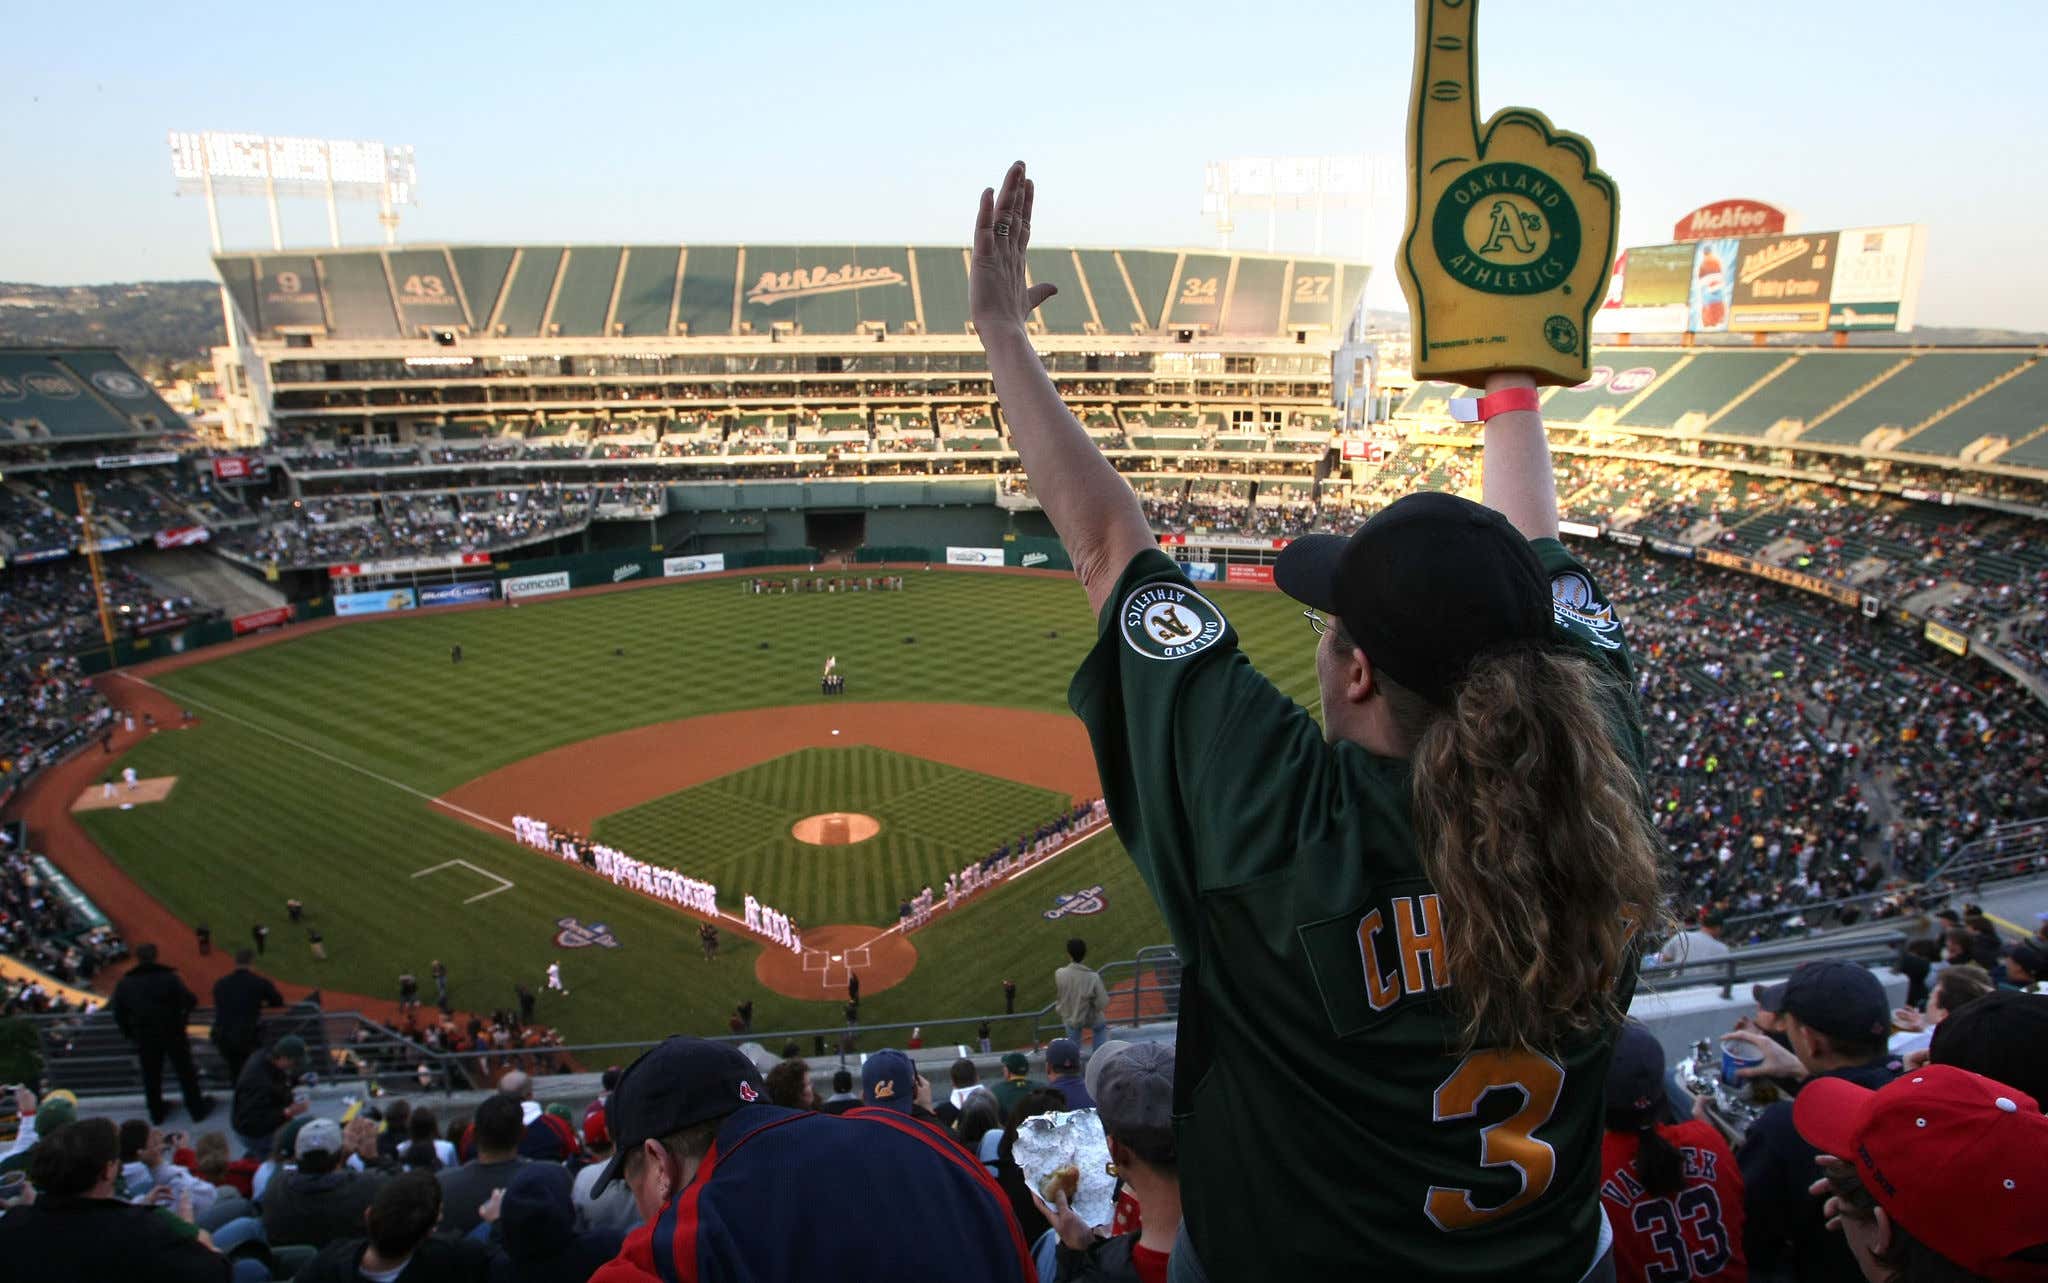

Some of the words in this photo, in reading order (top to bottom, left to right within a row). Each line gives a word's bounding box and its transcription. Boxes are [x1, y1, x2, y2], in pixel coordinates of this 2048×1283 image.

[1454, 171, 1560, 208] OAKLAND
[1479, 201, 1542, 254] A's
[1691, 209, 1767, 231] McAfee
[277, 272, 301, 293] 9
[402, 275, 446, 297] 43
[746, 264, 905, 298] Athletics
[1182, 277, 1218, 297] 34
[1296, 276, 1332, 295] 27
[1450, 253, 1564, 288] ATHLETICS
[510, 575, 567, 592] comcast
[1128, 588, 1185, 628] ATHLETICS
[1164, 621, 1218, 656] OAKLAND
[1424, 1048, 1566, 1232] 3
[1632, 1183, 1732, 1283] 33
